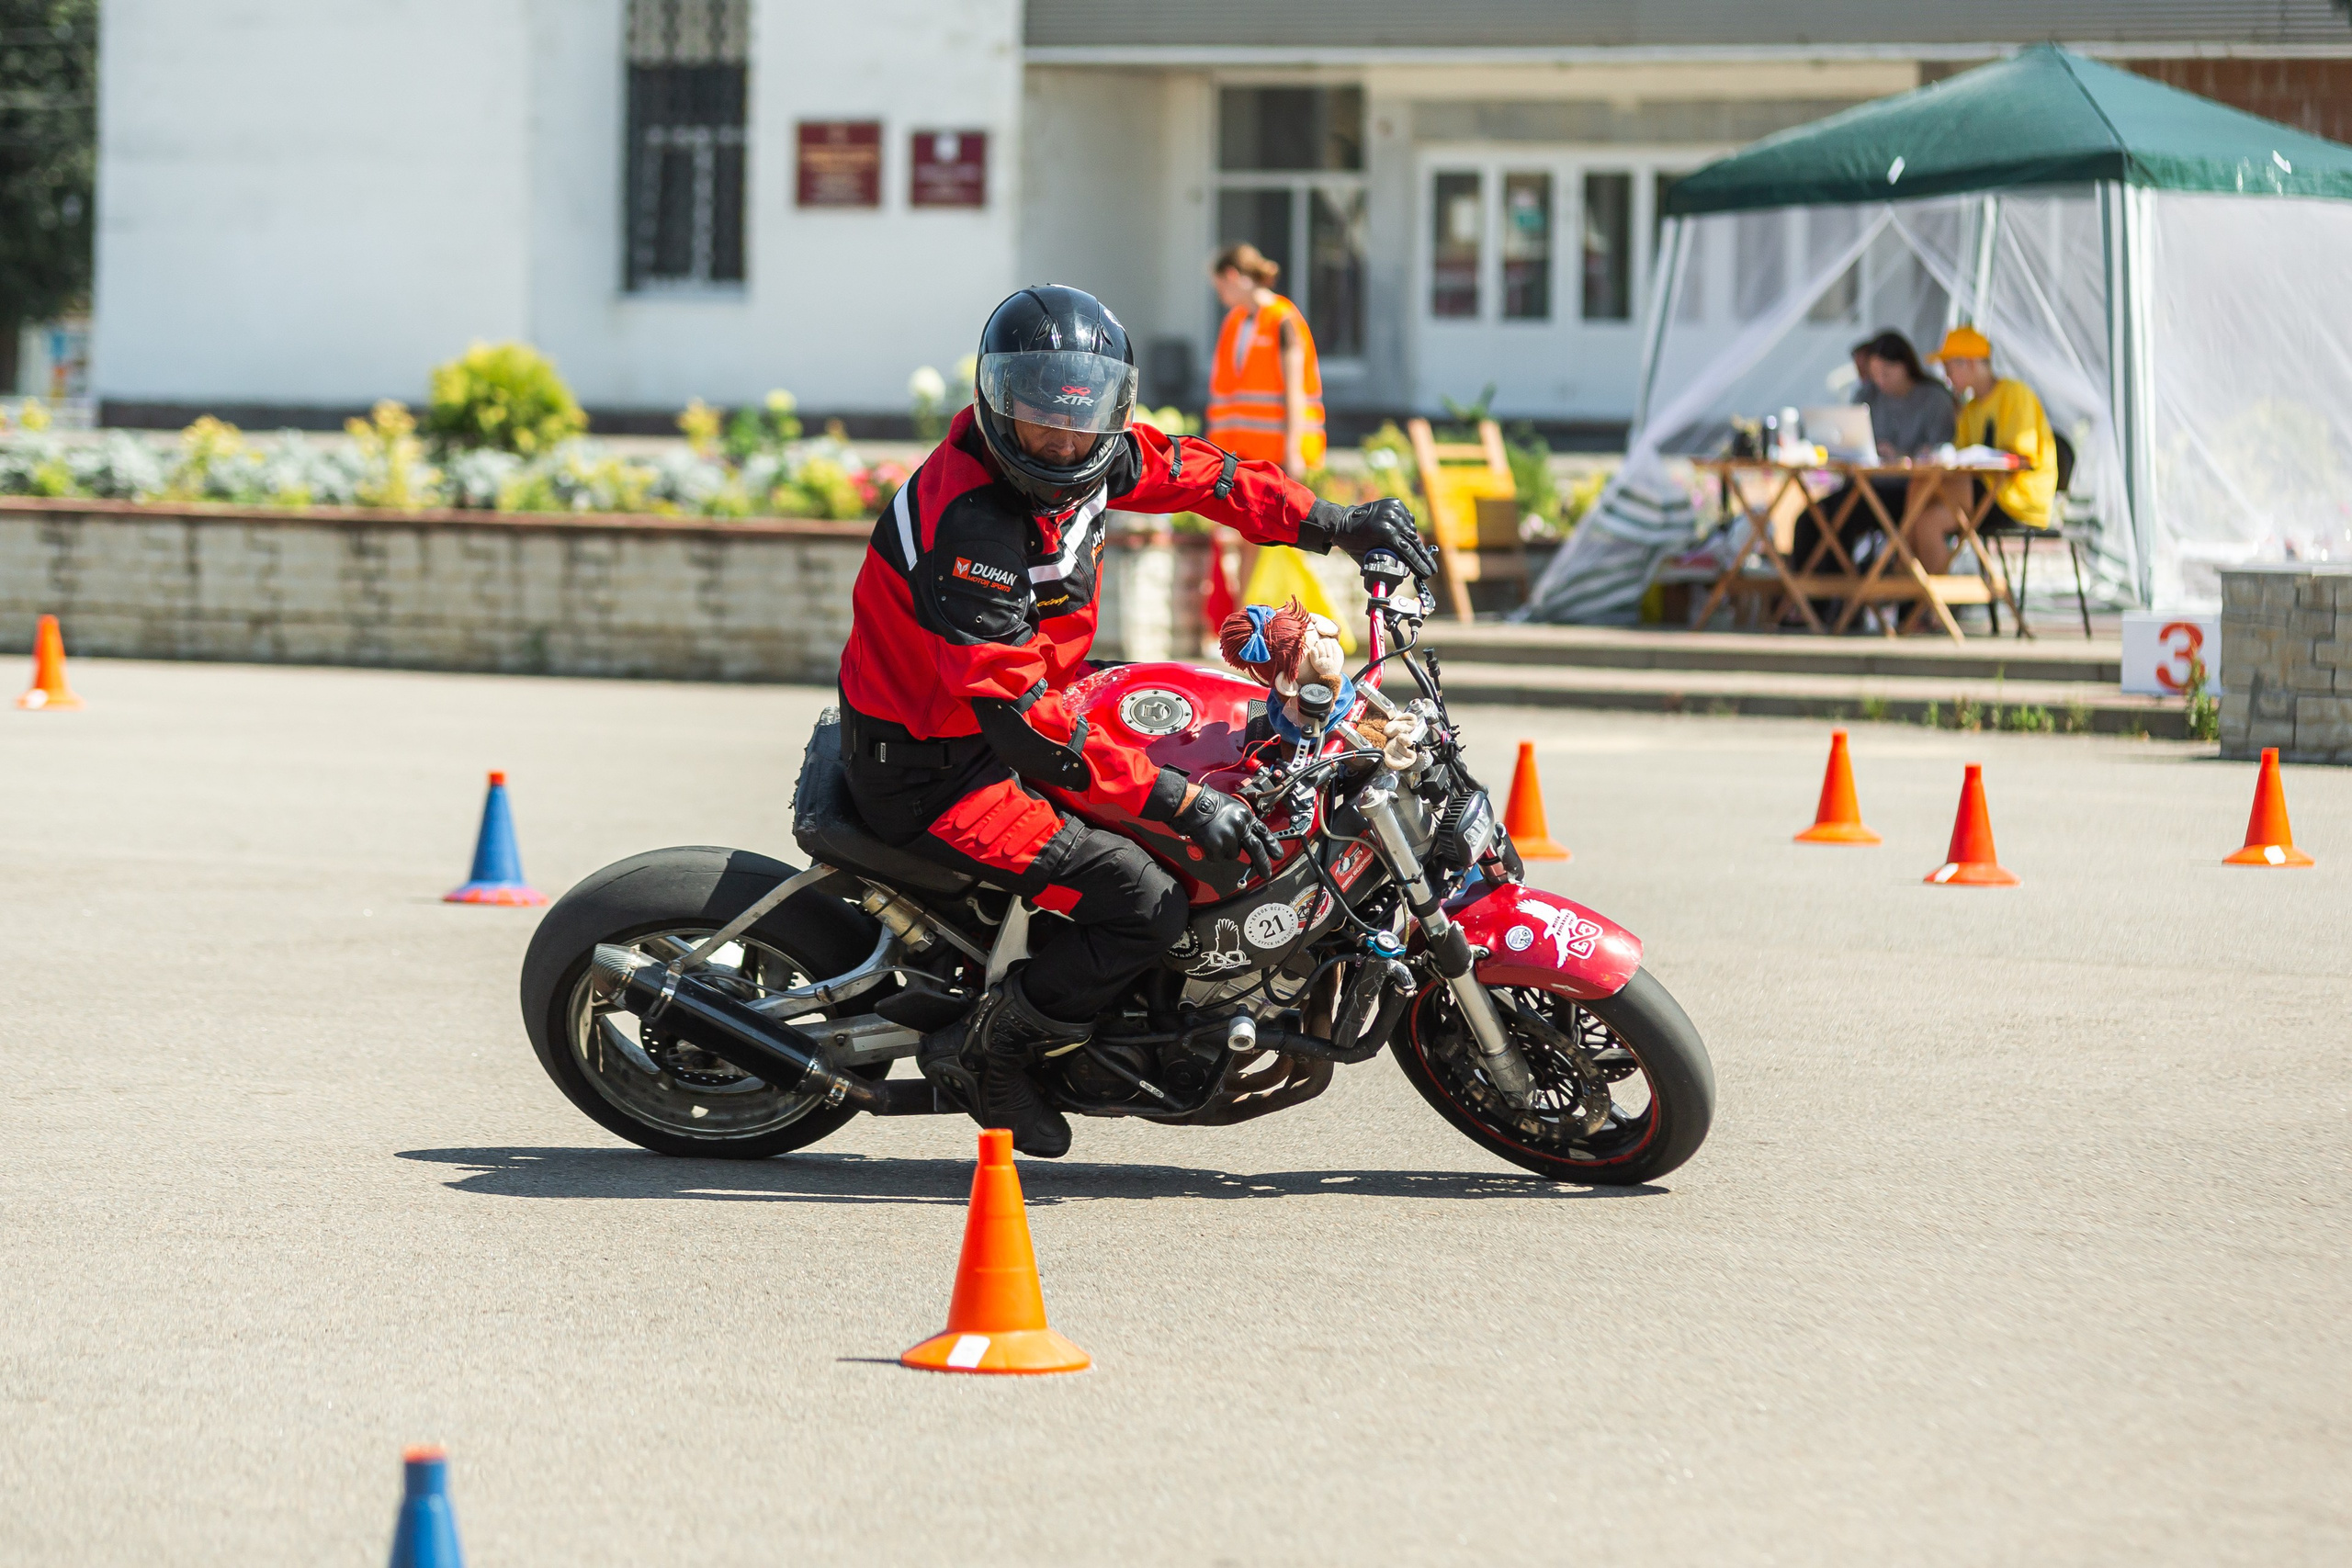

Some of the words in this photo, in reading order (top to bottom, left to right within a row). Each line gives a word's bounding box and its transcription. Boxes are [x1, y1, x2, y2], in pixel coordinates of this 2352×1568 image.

[1052, 393, 1094, 407] XTR
[967, 576, 990, 588] MOTOR
[990, 581, 1012, 592] SPORTS
[970, 562, 1018, 586] DUHAN
[2155, 621, 2206, 694] 3
[1259, 914, 1286, 939] 21
